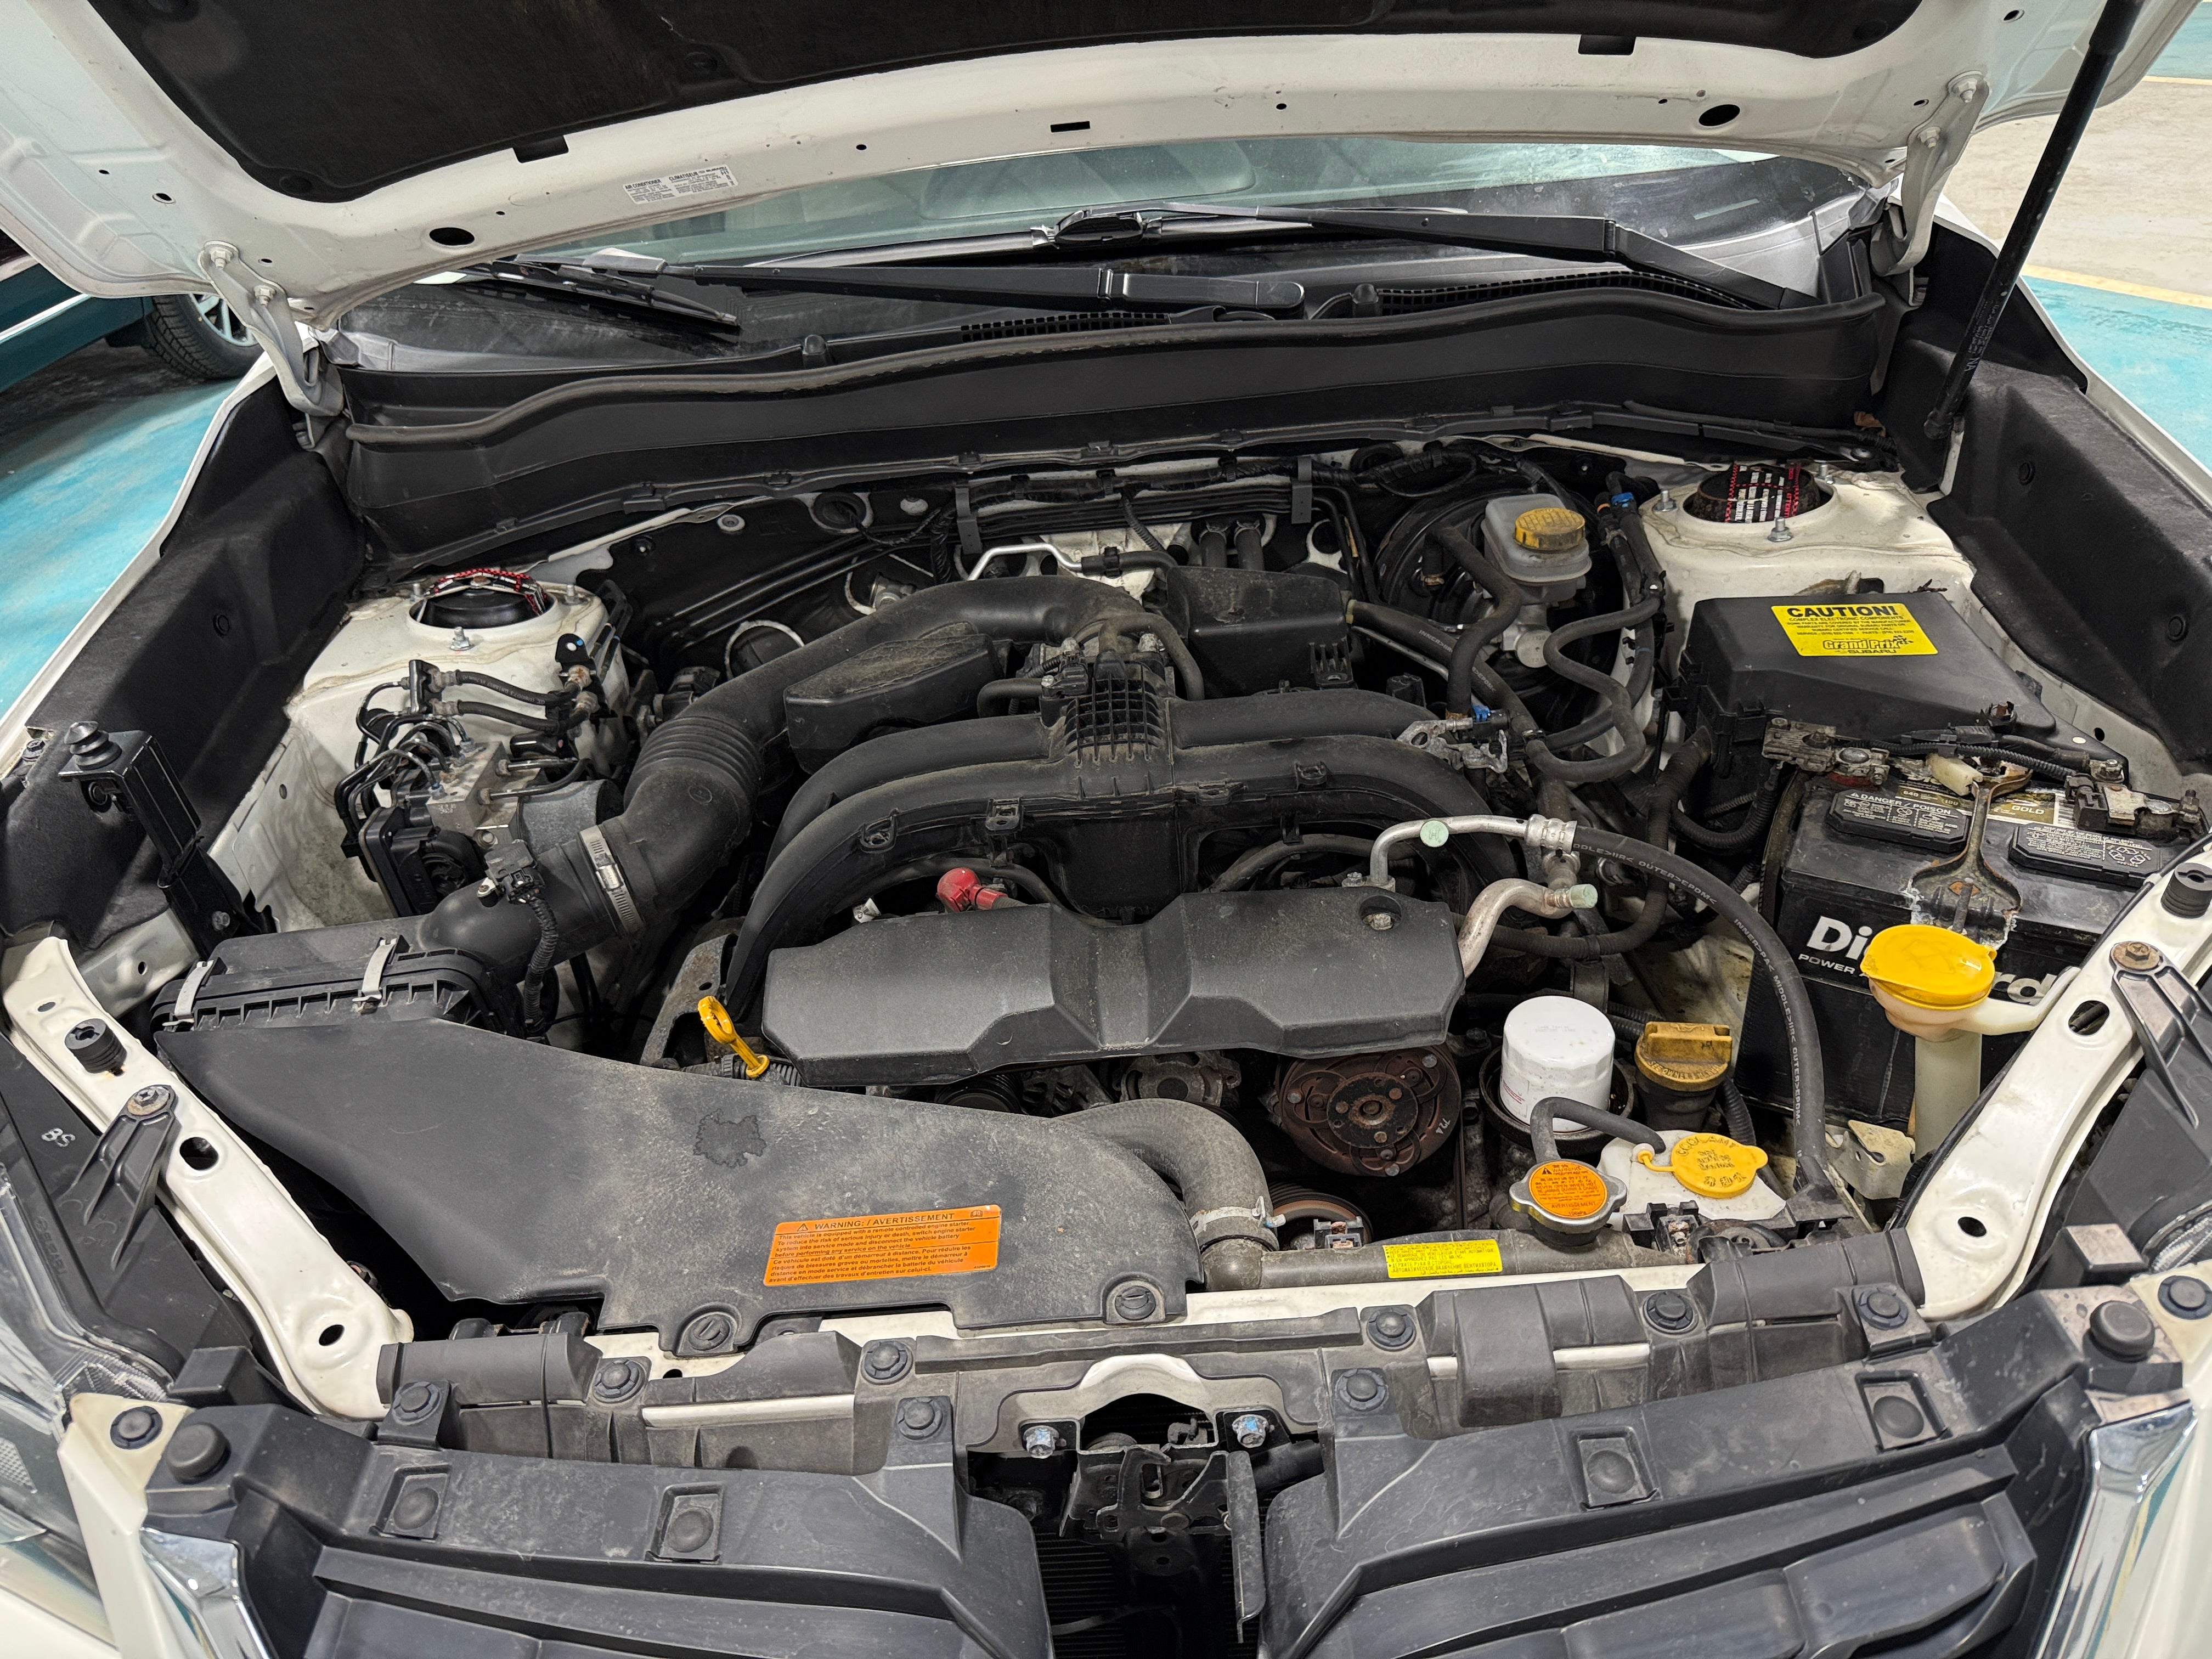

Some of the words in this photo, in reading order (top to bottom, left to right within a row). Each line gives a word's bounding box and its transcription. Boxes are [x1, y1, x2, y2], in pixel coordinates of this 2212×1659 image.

[669, 172, 698, 180] CLIMATISEUR
[633, 179, 662, 188] CONDITIONER
[1787, 606, 1898, 617] CAUTION!
[1823, 640, 1869, 650] Grand
[1869, 639, 1900, 649] Prix
[1860, 794, 1903, 806] DANGER
[1913, 804, 1951, 815] POISON
[2012, 805, 2045, 815] GOLD
[1798, 953, 1856, 975] POWER
[815, 1220, 865, 1229] WARNING:
[873, 1213, 955, 1224] AVERTISSEMENT
[858, 1262, 894, 1271] débrancher
